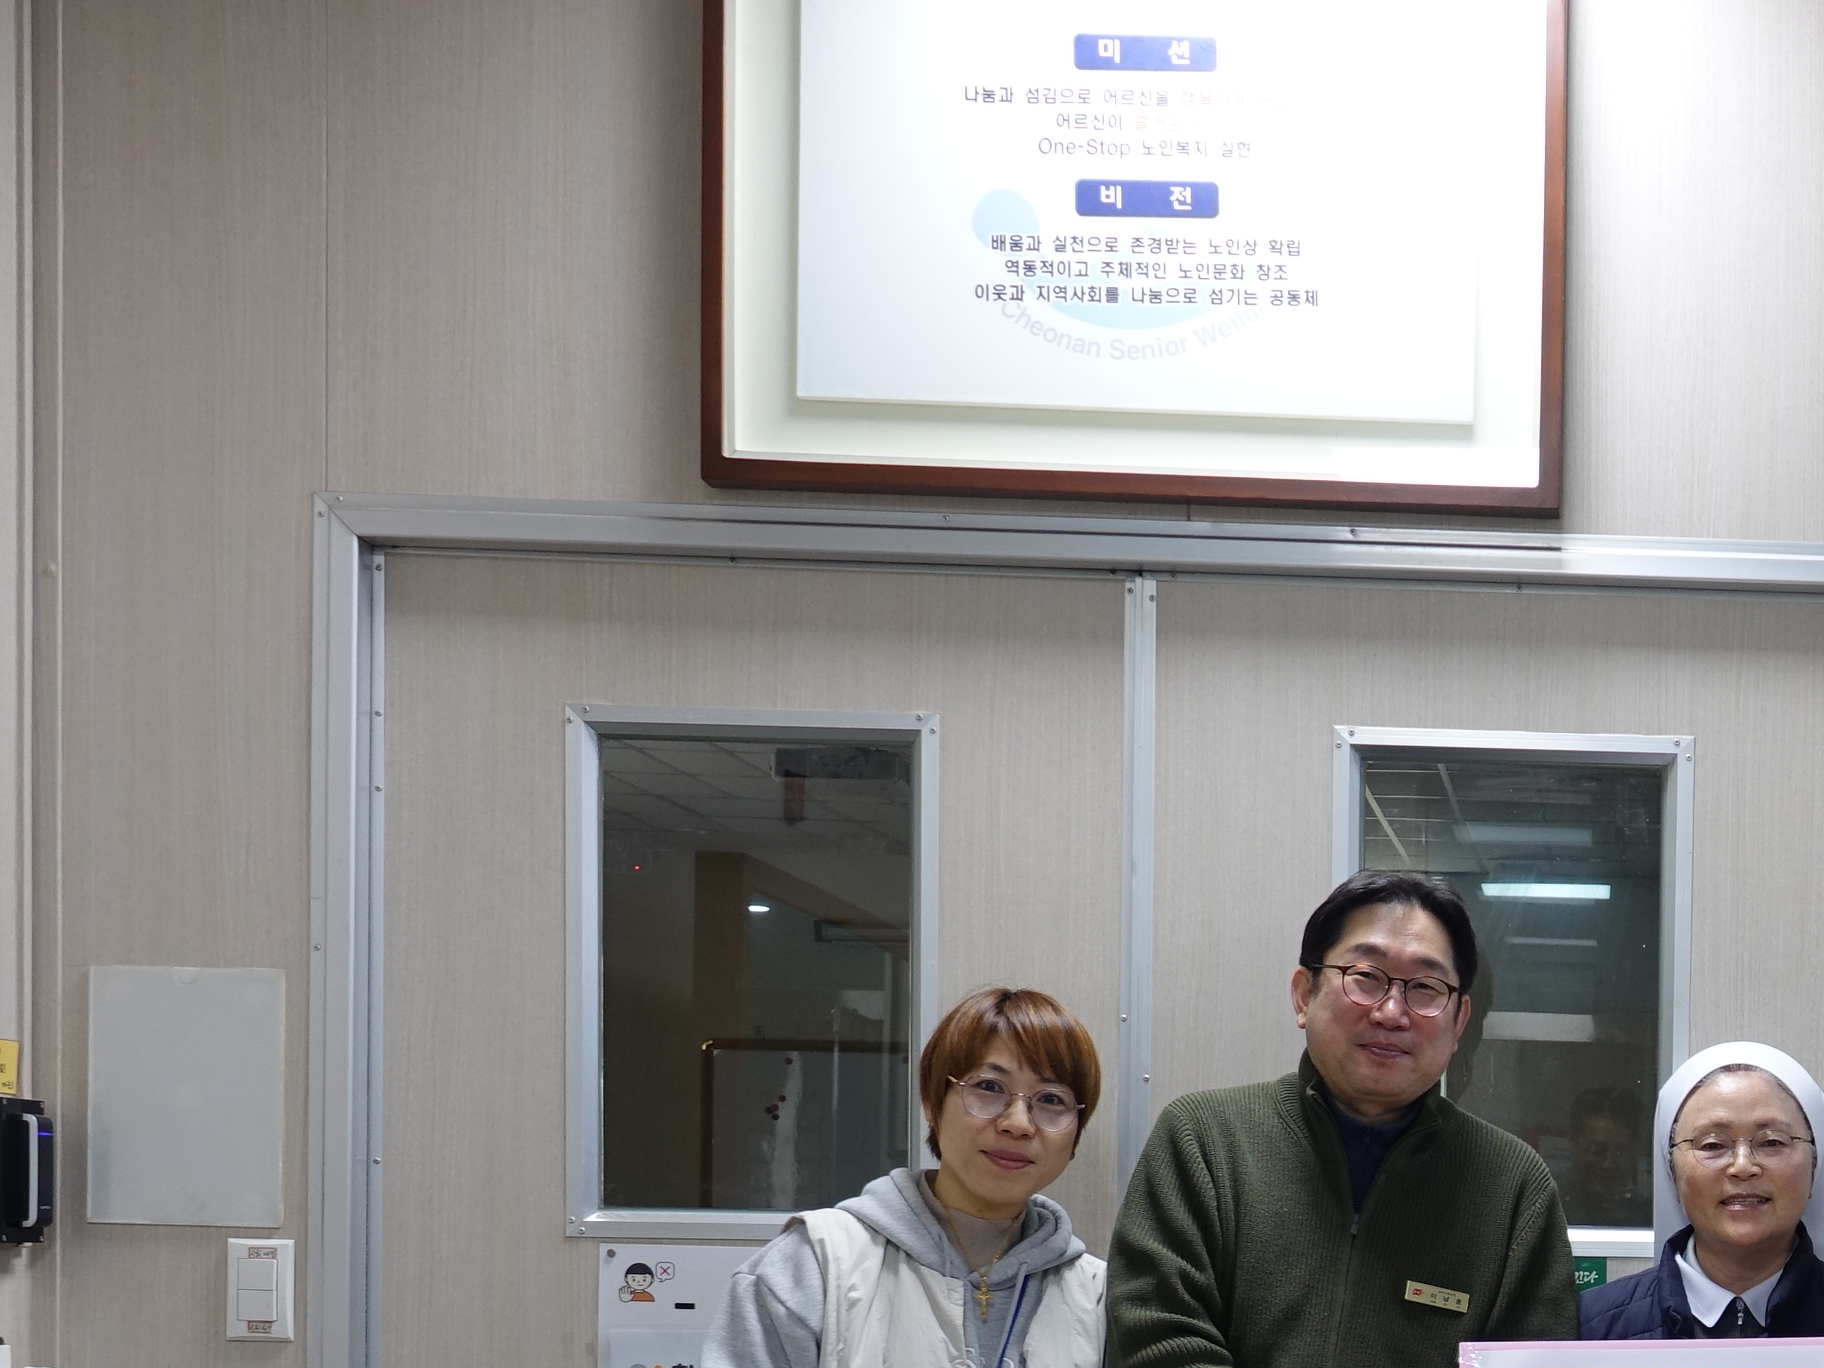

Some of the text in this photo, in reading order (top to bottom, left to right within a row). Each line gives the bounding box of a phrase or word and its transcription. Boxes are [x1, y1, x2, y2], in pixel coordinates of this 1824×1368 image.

[964, 86, 1169, 107] 나눔과 섬김으로 어르신을
[1056, 112, 1123, 132] 어르신이
[1038, 137, 1252, 159] One-Stop 노인복지 실현
[991, 234, 1301, 257] 배움과 실천으로 존경받는 노인상 확립
[1004, 259, 1289, 281] 역동적이고 주체적인 노인문화 창조
[975, 284, 1319, 308] 이웃과 지역사회를 나눔으로 섬기는 공동체
[1000, 300, 1189, 362] Cheonan Senior
